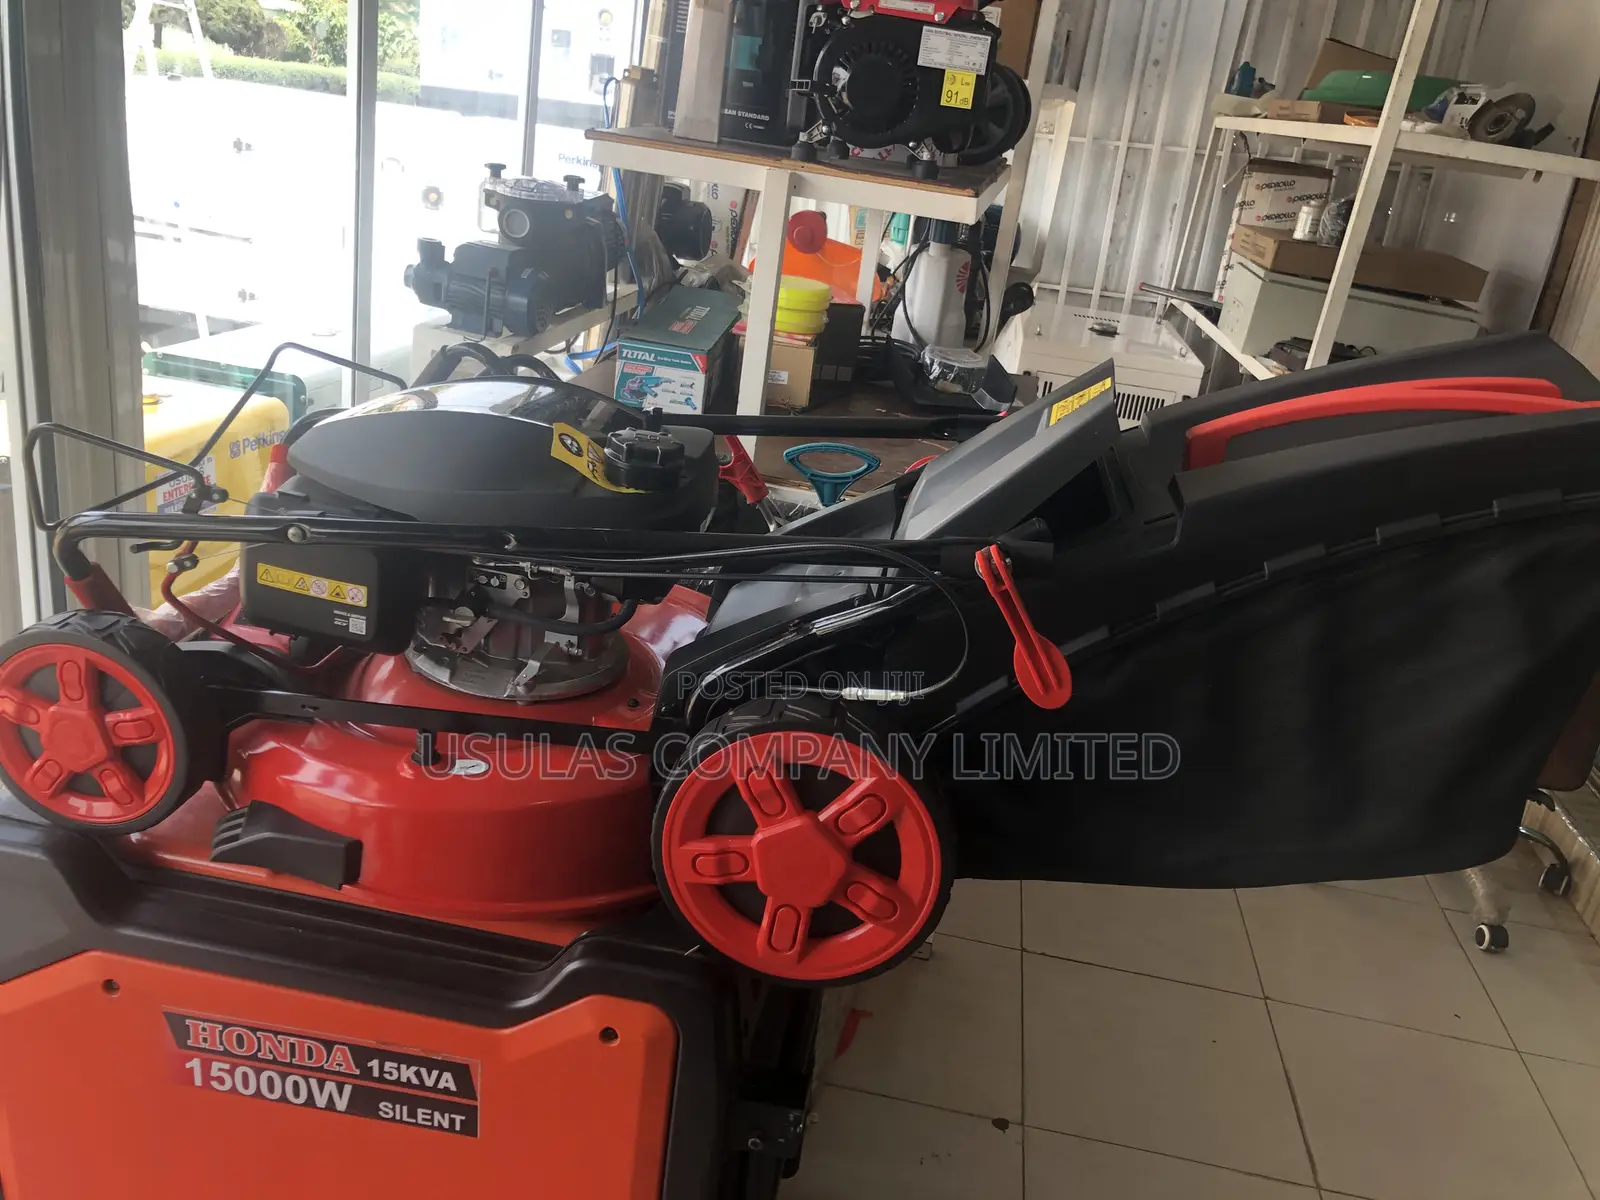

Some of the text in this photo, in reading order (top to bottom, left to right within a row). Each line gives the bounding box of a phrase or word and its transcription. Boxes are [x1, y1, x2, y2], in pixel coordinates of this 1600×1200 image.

[738, 110, 770, 121] STANDARD
[1261, 180, 1296, 191] PEDROLLO
[1261, 212, 1297, 223] PEDROLLO
[622, 349, 656, 362] TOTAL
[185, 1019, 458, 1092] HONDA 15KVA
[184, 1057, 353, 1112] 15000W
[378, 1101, 466, 1132] SILENT
